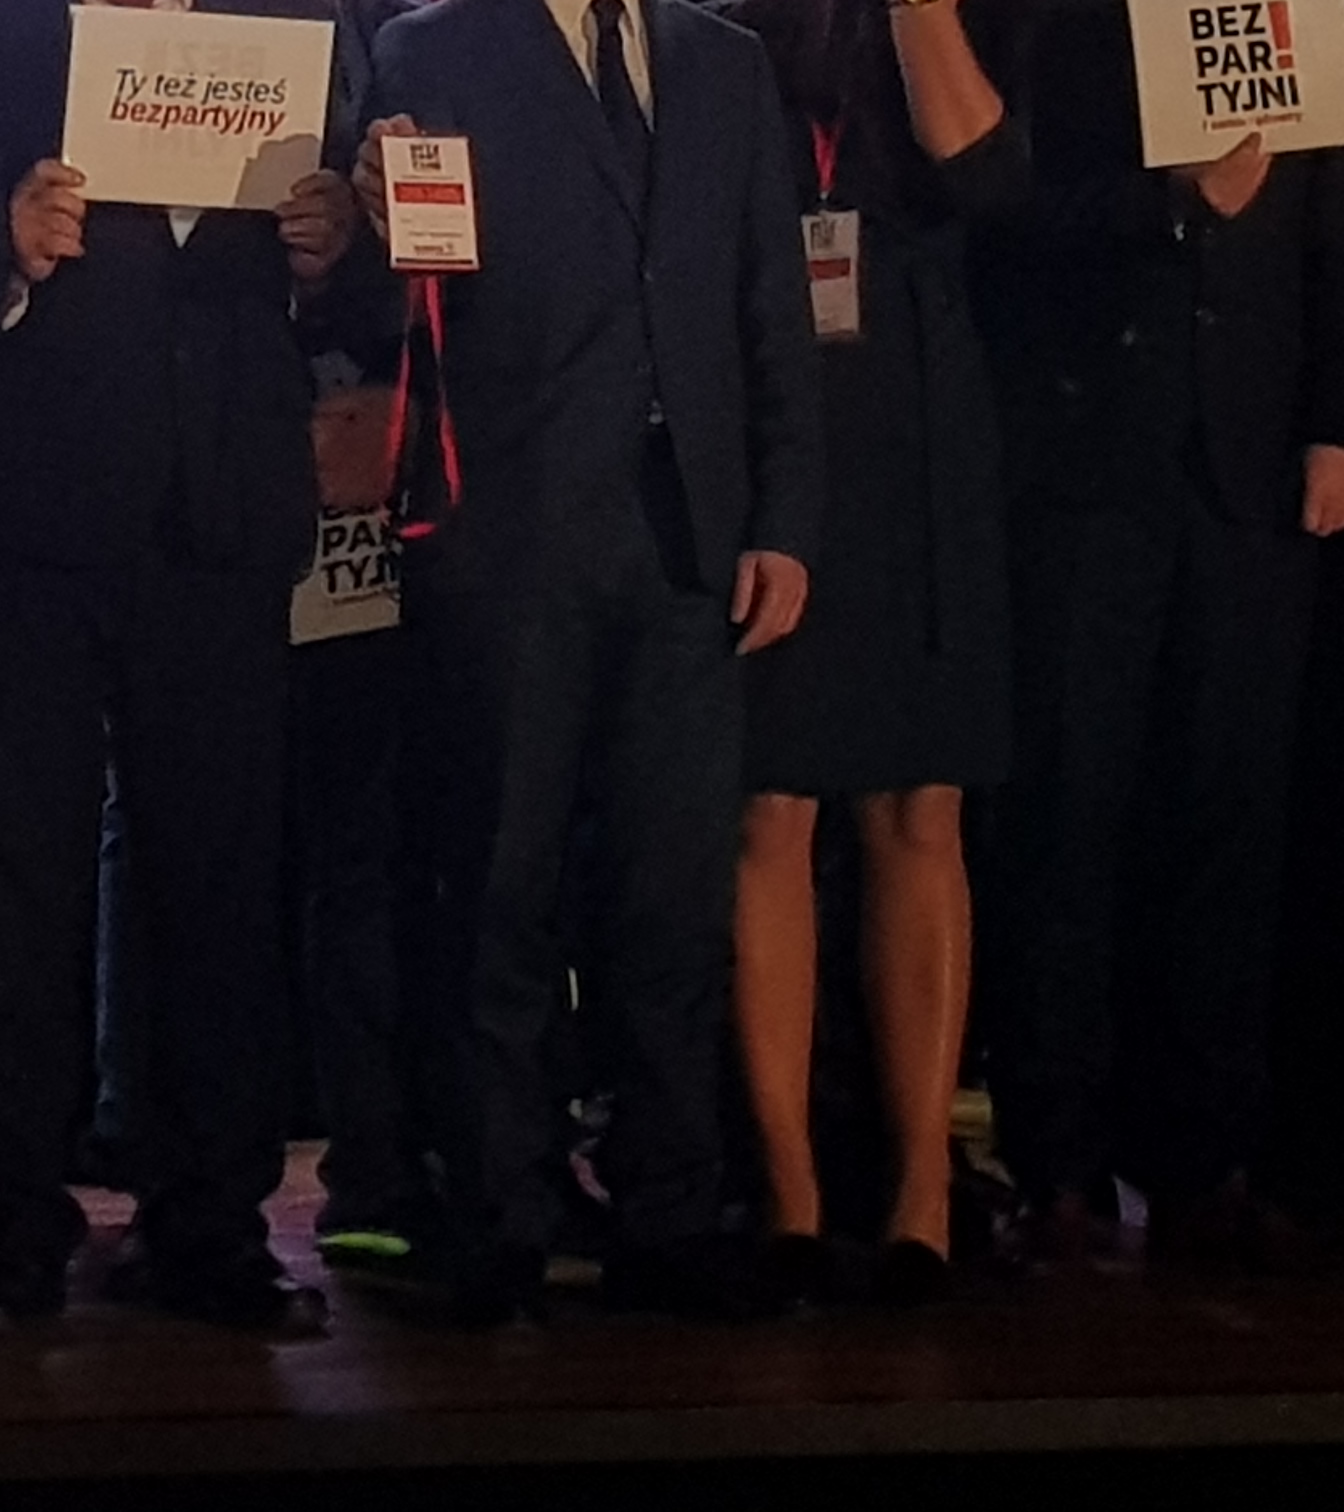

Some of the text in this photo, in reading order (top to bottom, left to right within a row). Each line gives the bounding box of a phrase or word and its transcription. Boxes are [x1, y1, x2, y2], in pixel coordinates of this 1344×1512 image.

[1189, 3, 1267, 40] BEZ
[1195, 40, 1274, 78] PAR
[115, 68, 288, 106] Ty też jesteś
[1196, 74, 1300, 116] TYJNI
[109, 94, 288, 137] bezpartyjny
